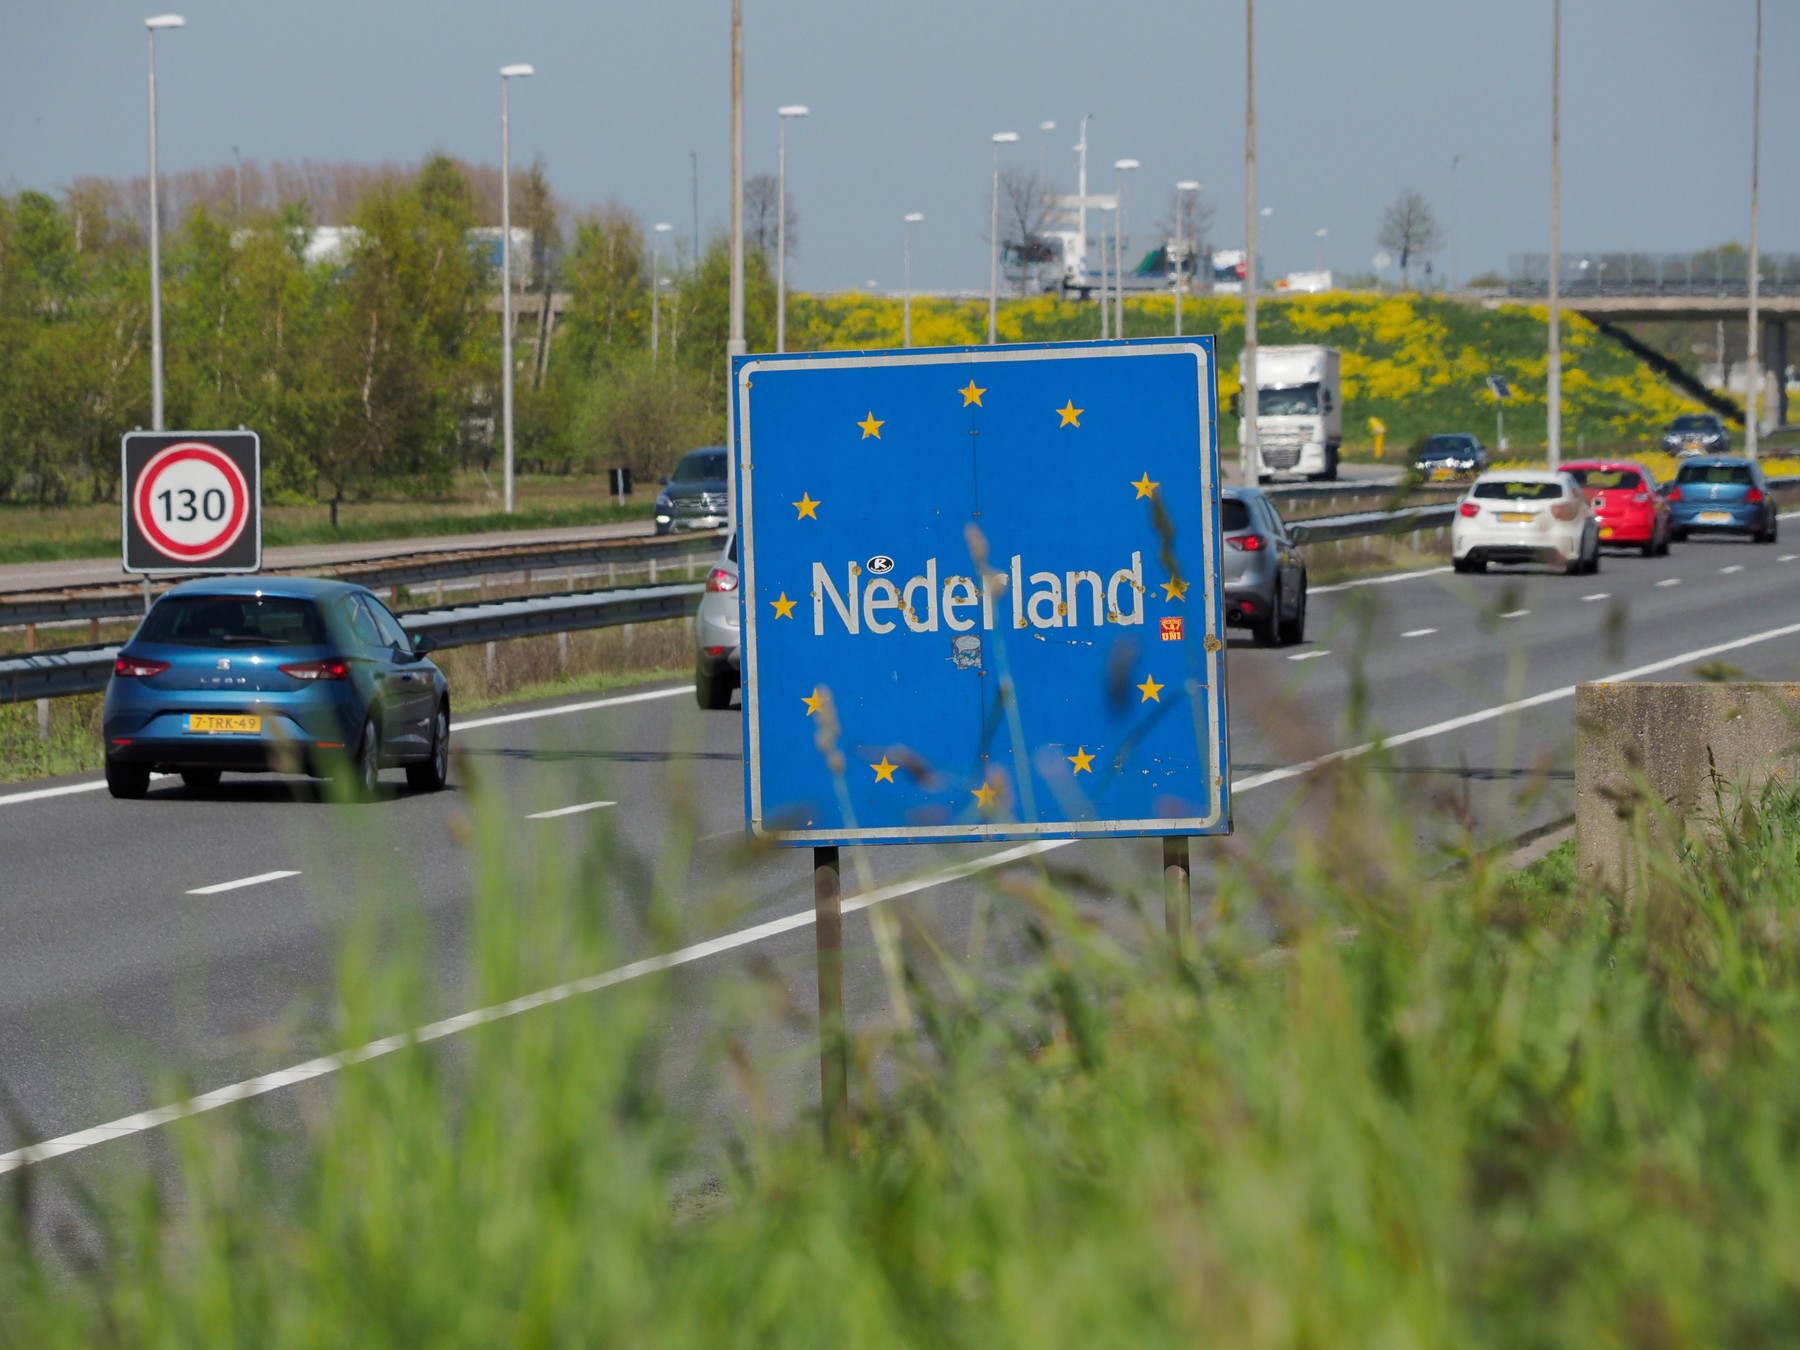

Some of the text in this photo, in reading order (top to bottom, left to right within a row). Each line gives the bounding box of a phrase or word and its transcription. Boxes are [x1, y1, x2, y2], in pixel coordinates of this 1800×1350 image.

[157, 488, 226, 522] 130
[812, 550, 1144, 636] Nederland
[194, 716, 257, 730] 7-TRK-49
